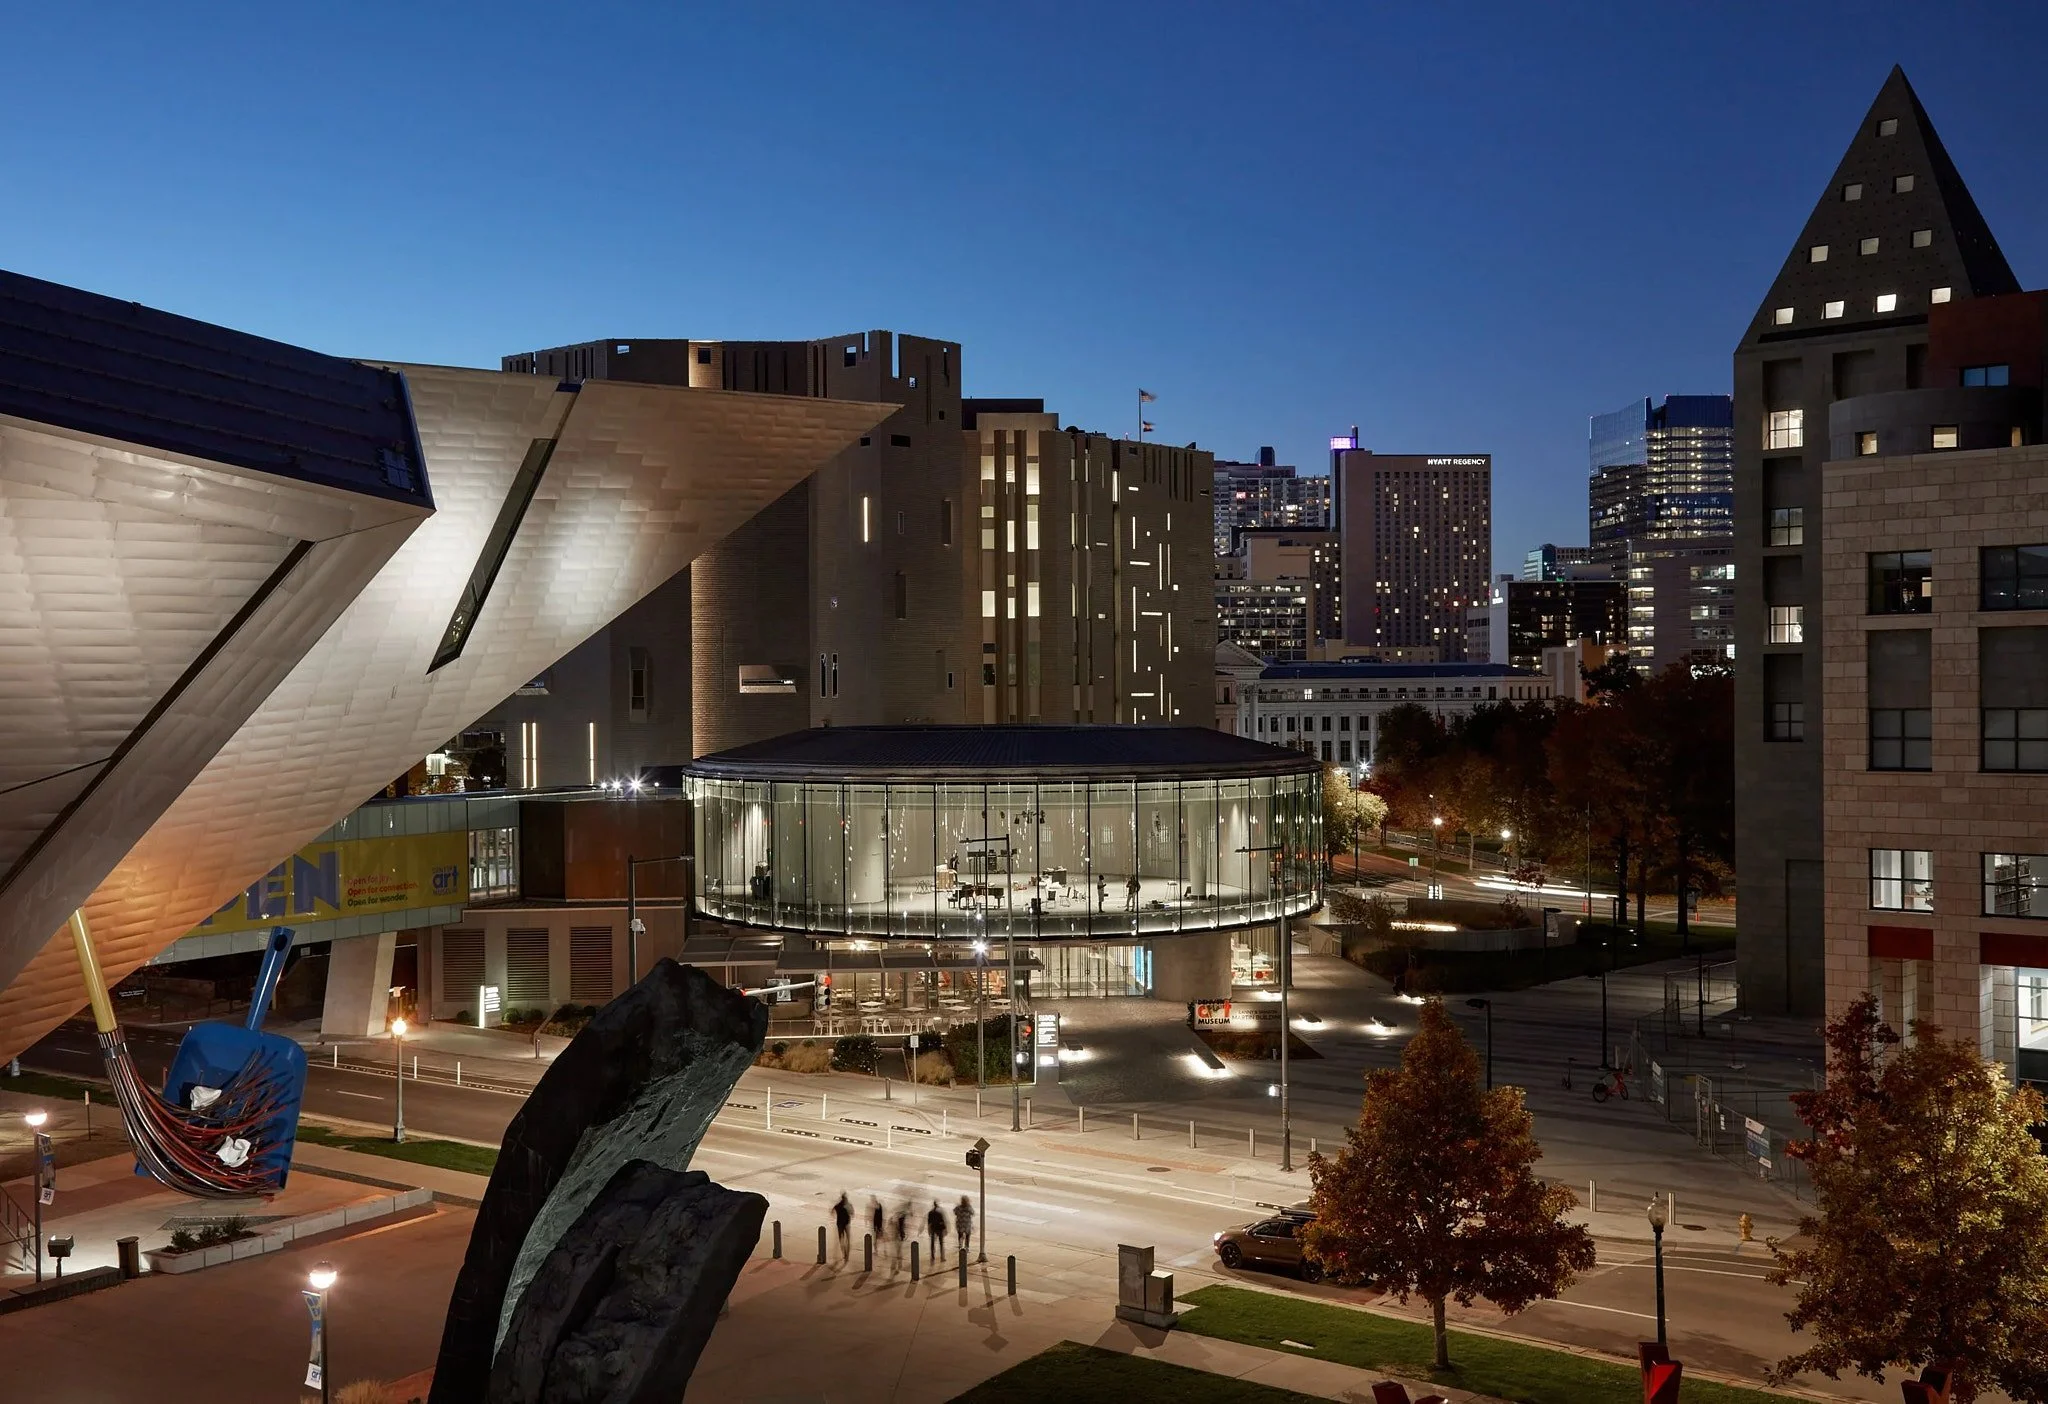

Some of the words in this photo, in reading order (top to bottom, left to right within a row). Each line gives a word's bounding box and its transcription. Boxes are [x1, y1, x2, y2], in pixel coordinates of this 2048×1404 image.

[432, 864, 459, 889] art
[199, 852, 340, 927] EN
[347, 886, 367, 897] Open
[367, 885, 379, 894] for
[347, 898, 367, 908] Open
[367, 896, 379, 904] for
